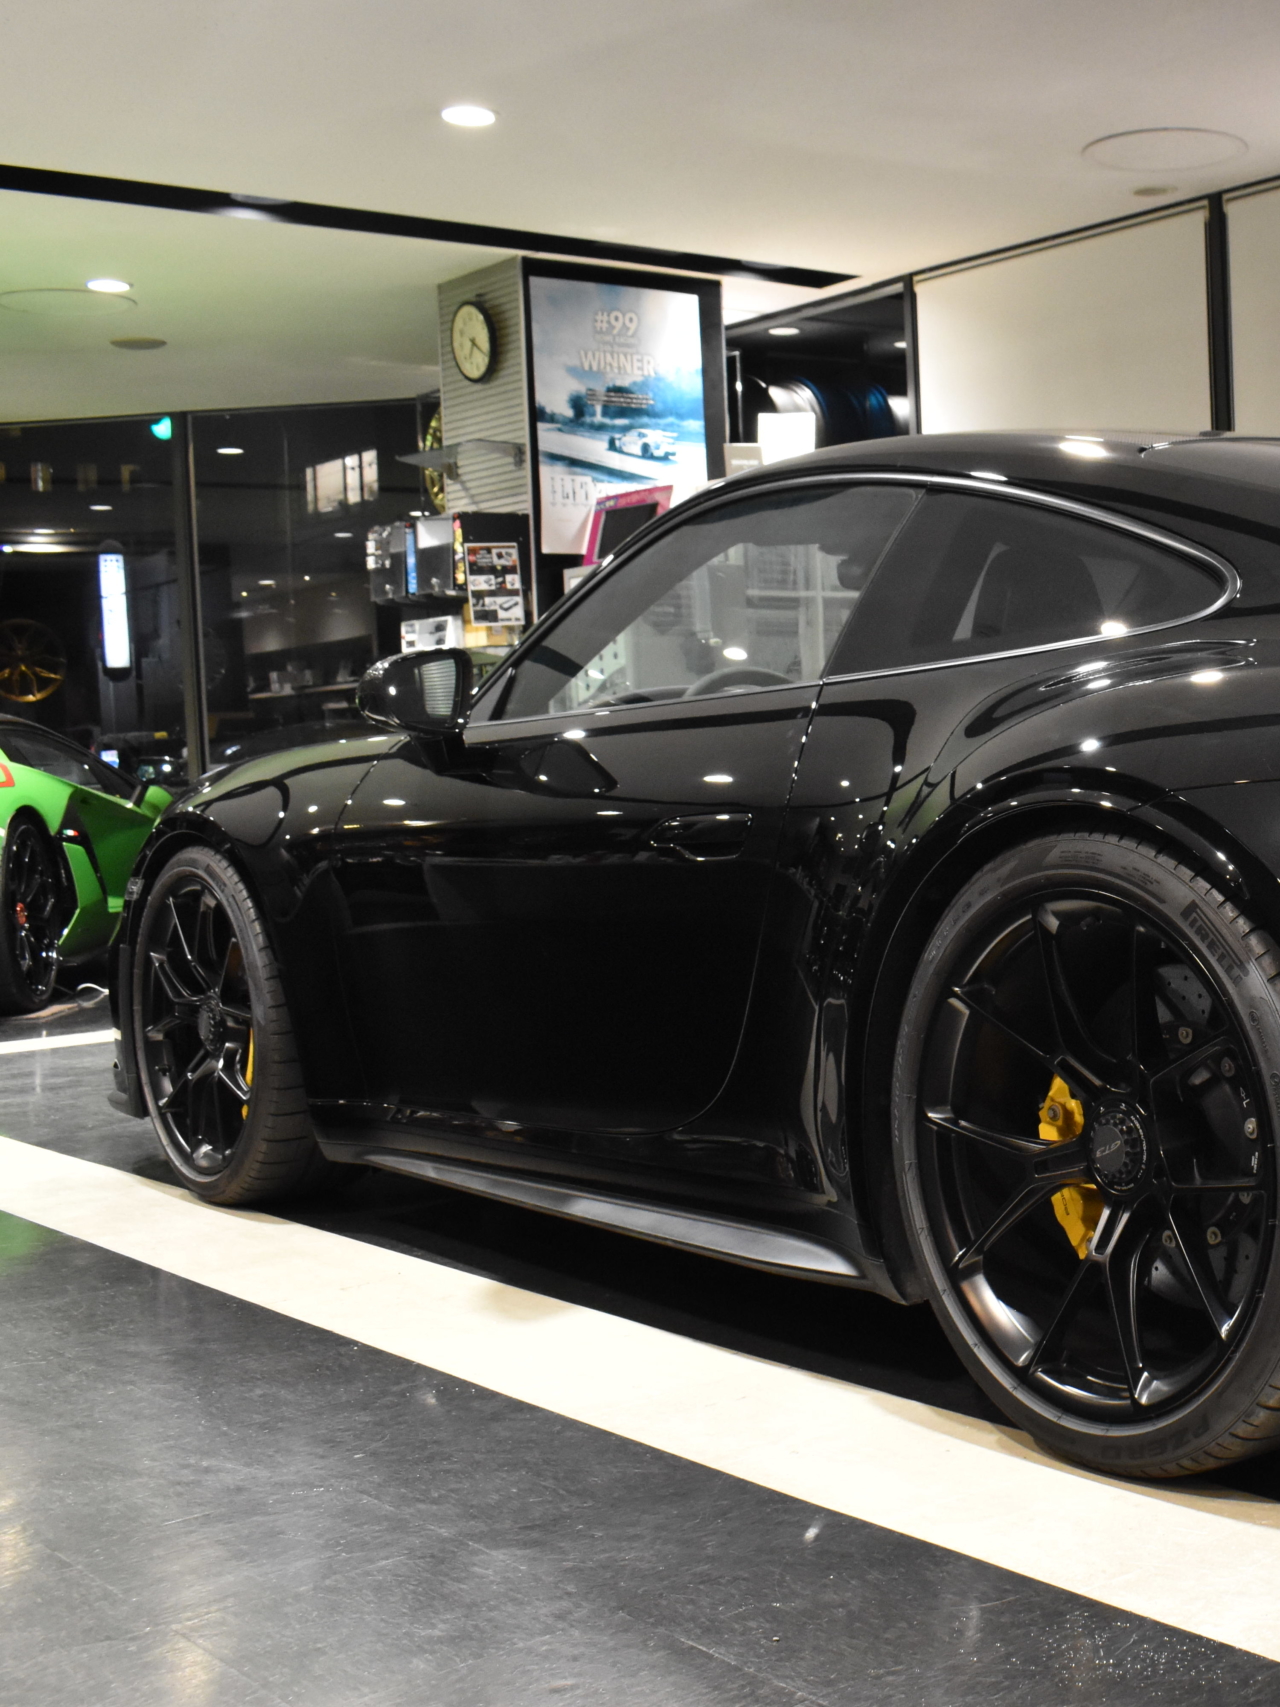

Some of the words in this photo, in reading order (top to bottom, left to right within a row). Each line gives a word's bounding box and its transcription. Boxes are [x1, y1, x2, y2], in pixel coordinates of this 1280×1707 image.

[594, 311, 639, 336] #99
[580, 349, 655, 377] WINNER
[1180, 899, 1250, 988] PIRELLI
[1095, 1139, 1122, 1159] GT3
